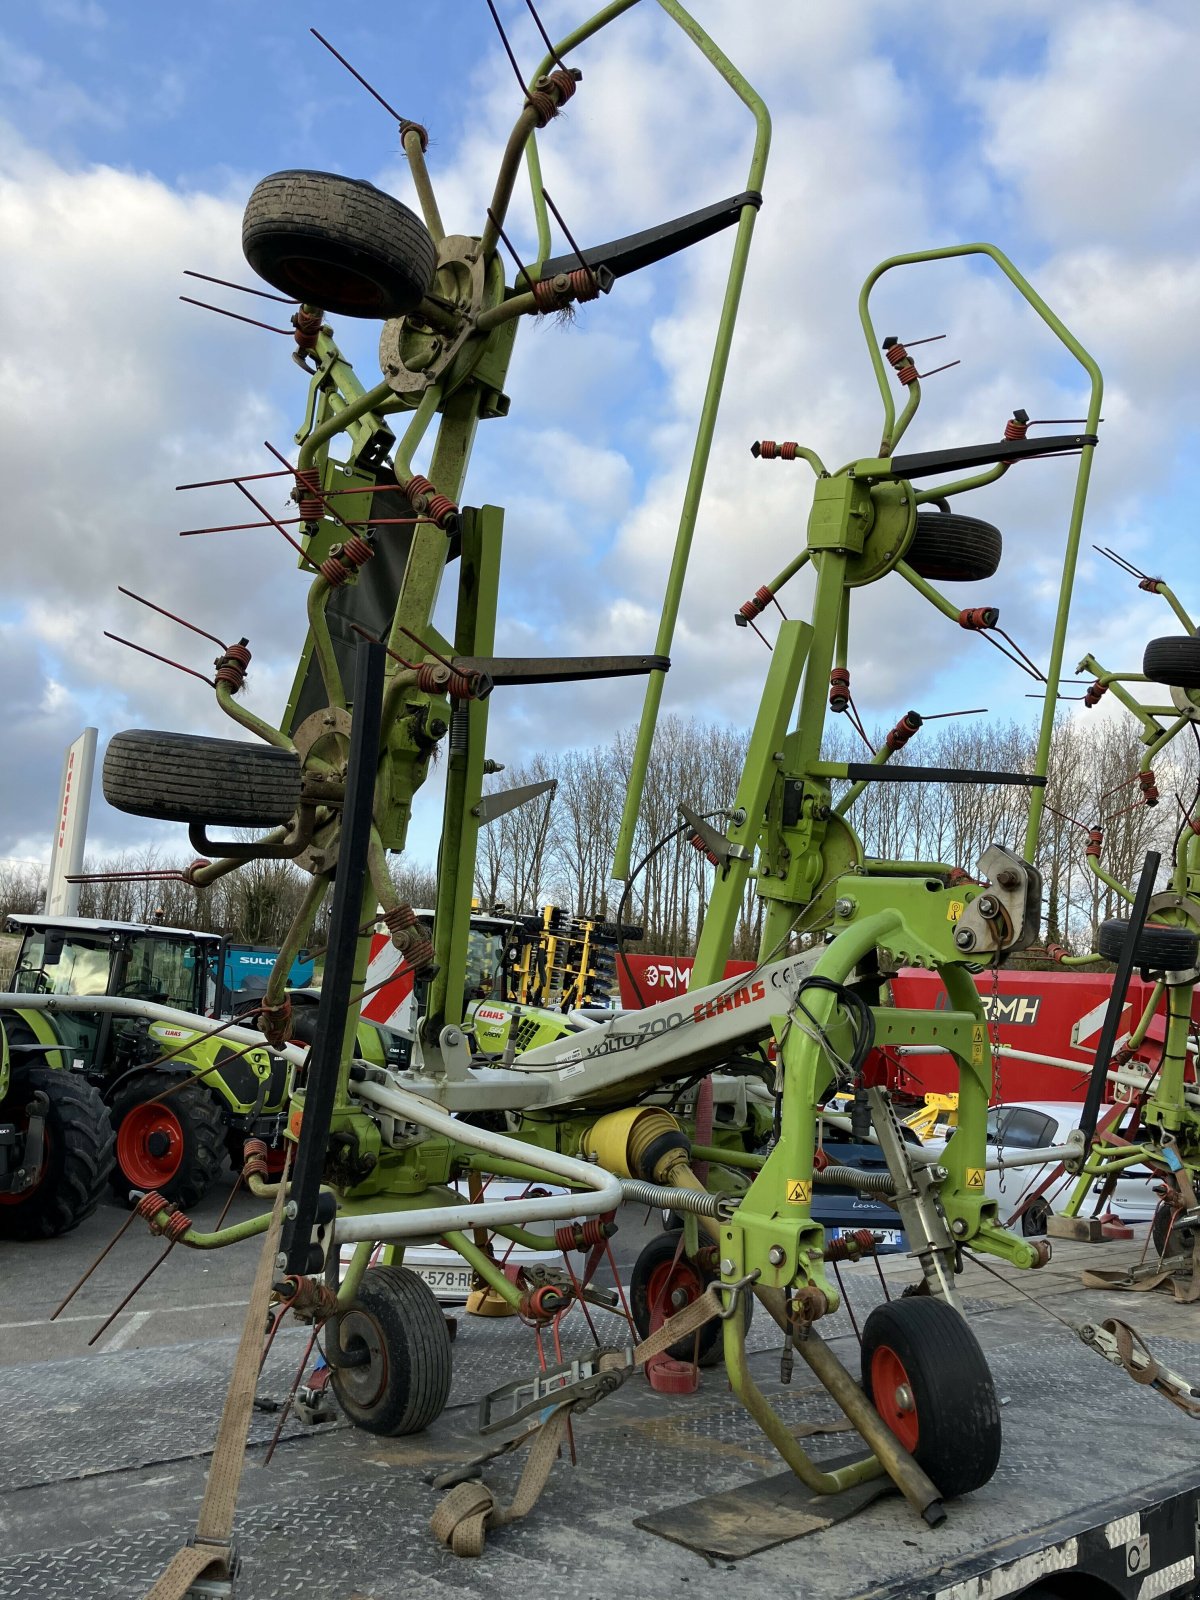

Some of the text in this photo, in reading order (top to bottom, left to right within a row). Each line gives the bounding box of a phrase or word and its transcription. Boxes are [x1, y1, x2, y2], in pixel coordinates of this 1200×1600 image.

[239, 956, 277, 966] SULK
[658, 964, 693, 989] RM
[693, 981, 766, 1023] CLAAS
[479, 1009, 505, 1020] CLAAS
[979, 996, 1040, 1024] RMH
[164, 1029, 182, 1037] CLAAS
[482, 1031, 501, 1039] ARION
[587, 1035, 635, 1057] VOLTO
[634, 1011, 684, 1050] 700
[852, 1201, 882, 1209] Leon
